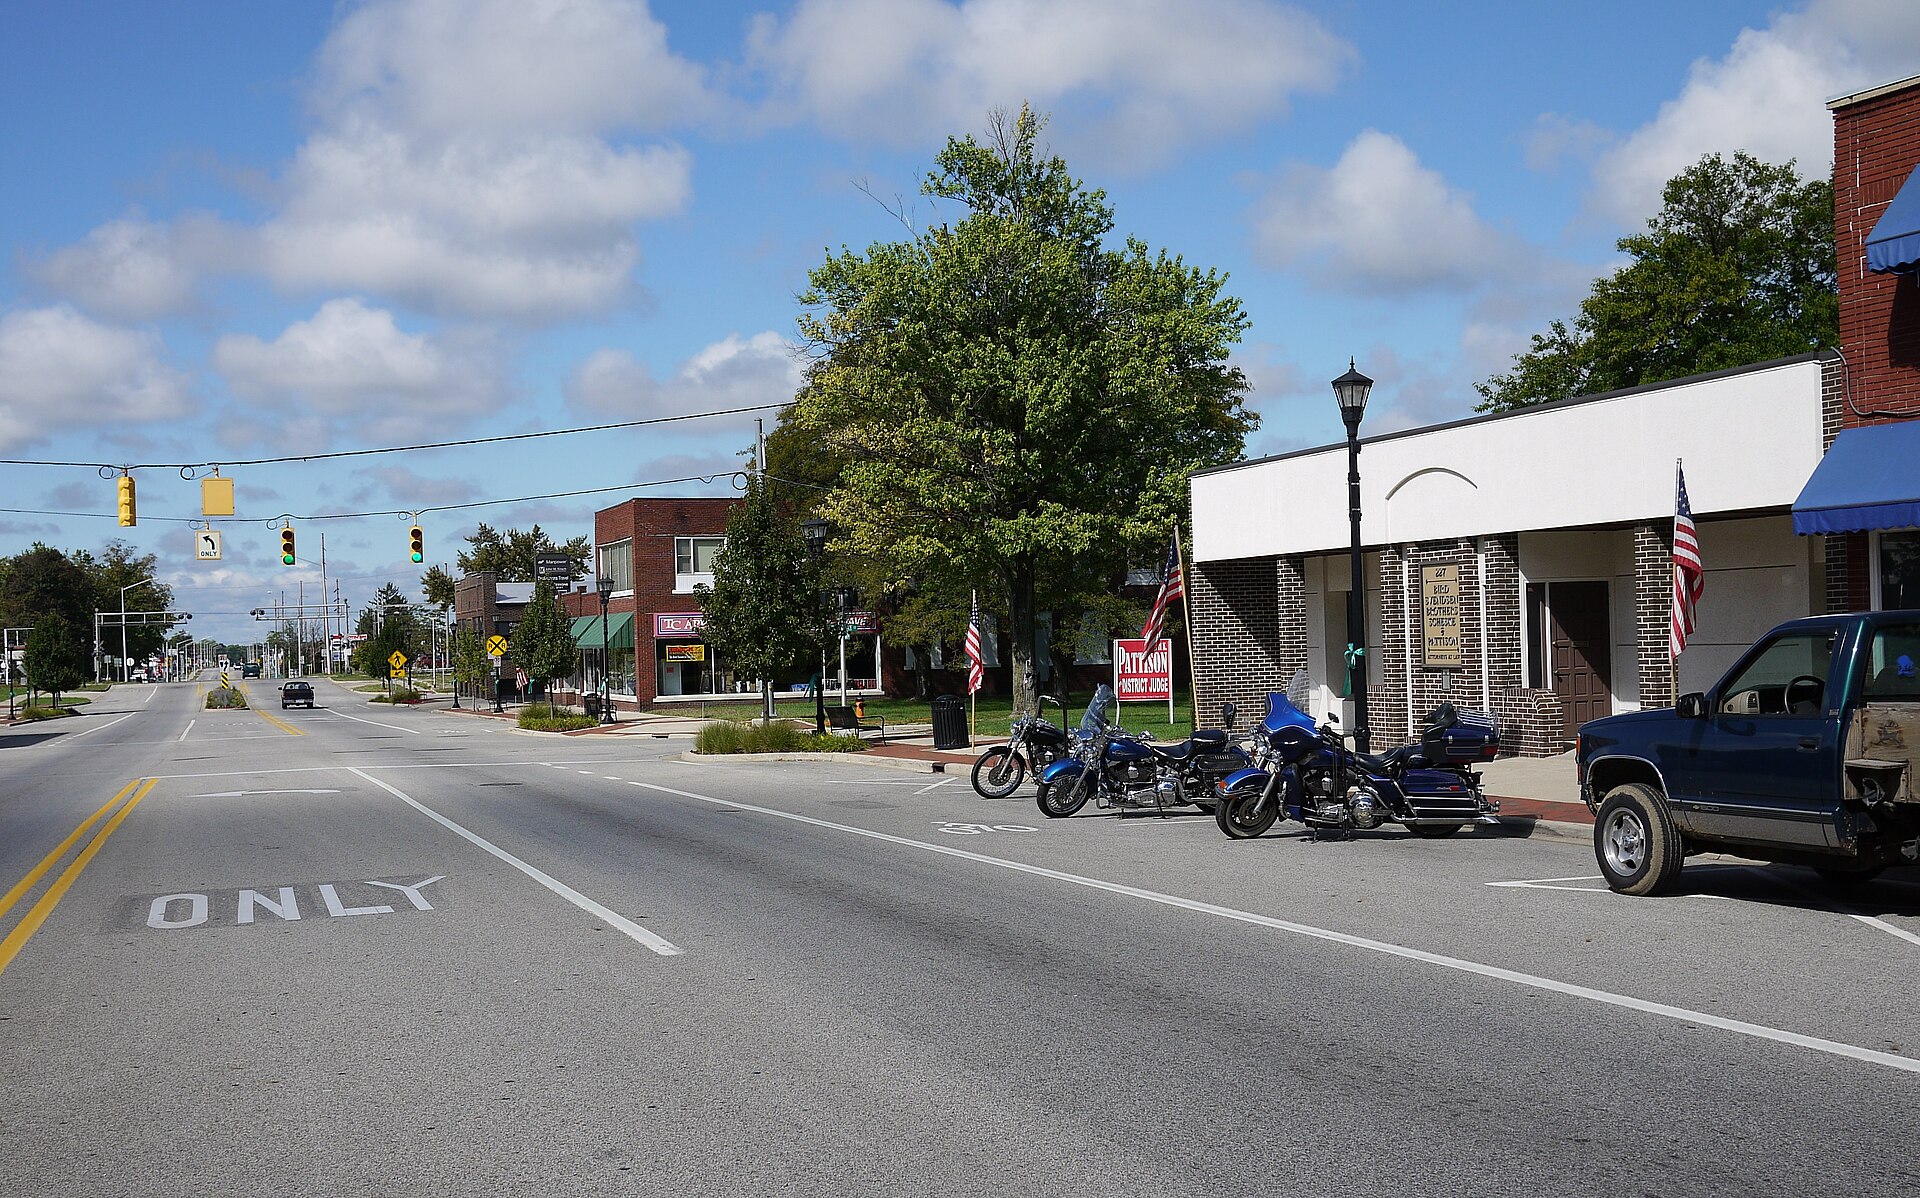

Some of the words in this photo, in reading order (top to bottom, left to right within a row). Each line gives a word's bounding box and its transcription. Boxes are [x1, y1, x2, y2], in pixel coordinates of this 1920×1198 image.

[1435, 567, 1447, 577] 227
[1433, 584, 1449, 594] BIRD
[1426, 606, 1459, 616] BROTHERS
[663, 618, 682, 630] TC
[1428, 636, 1459, 646] PATTISON
[1118, 646, 1168, 674] PATTISON
[1121, 677, 1149, 693] DISTRICT
[1148, 677, 1169, 693] JUDGE
[147, 876, 446, 929] ONLY
